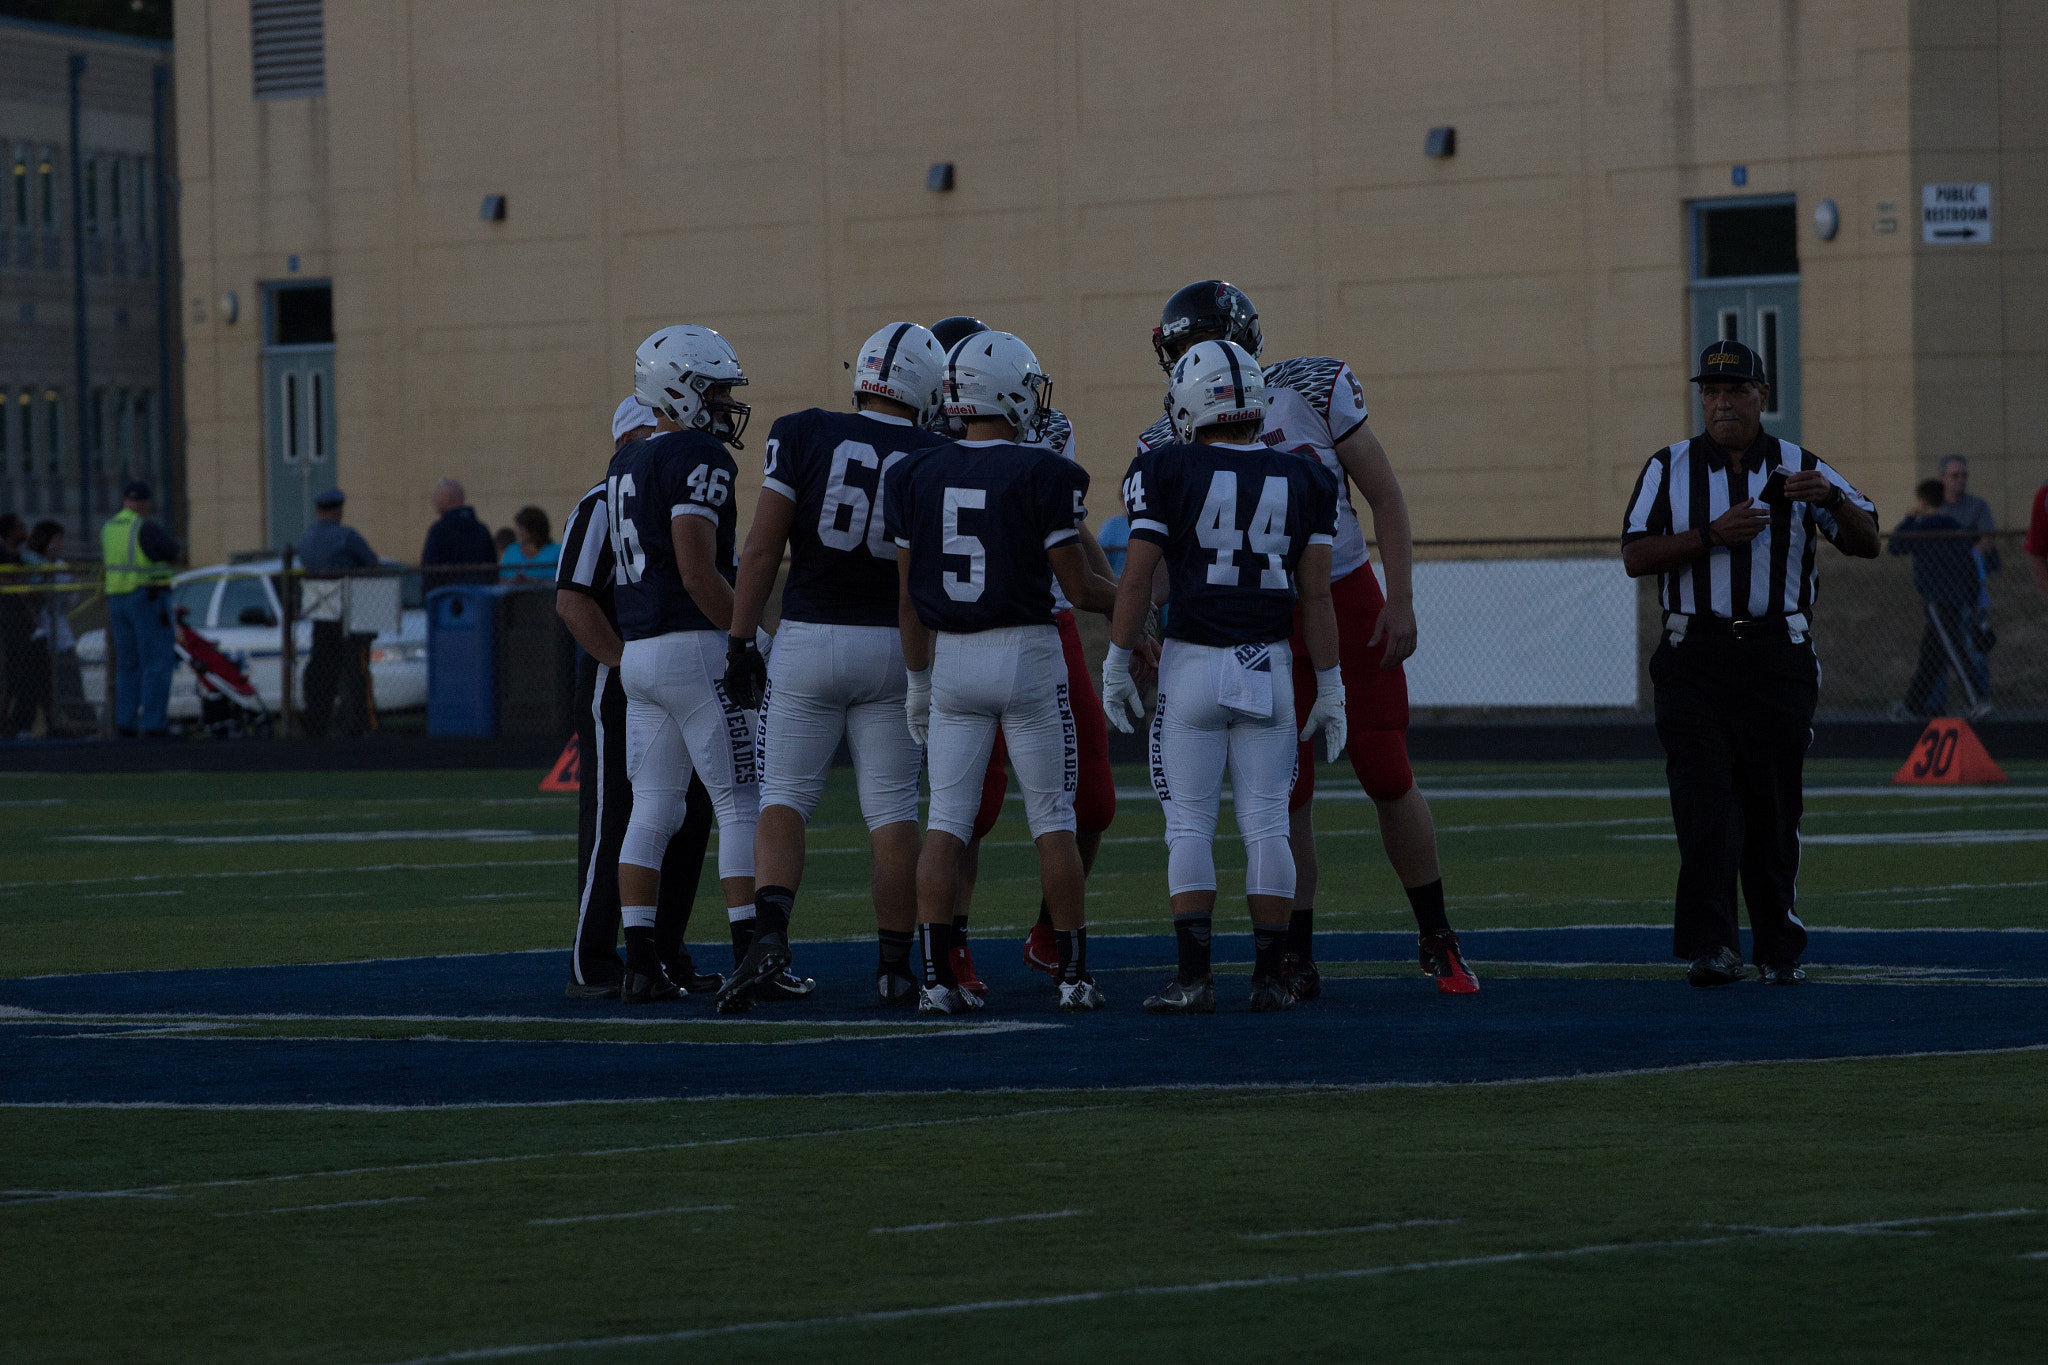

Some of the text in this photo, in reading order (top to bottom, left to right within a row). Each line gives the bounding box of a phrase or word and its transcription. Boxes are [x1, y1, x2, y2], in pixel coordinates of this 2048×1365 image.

[1924, 208, 1987, 221] RESTROOM
[1936, 187, 1977, 201] PUBLIC
[1217, 409, 1261, 422] Riddell
[687, 463, 731, 507] 46
[942, 487, 985, 602] 5
[1195, 470, 1291, 589] 44
[1057, 683, 1077, 792] RENEGADES
[1151, 693, 1172, 801] RENEGADES
[1914, 729, 1958, 777] 30
[559, 741, 580, 782] 2
